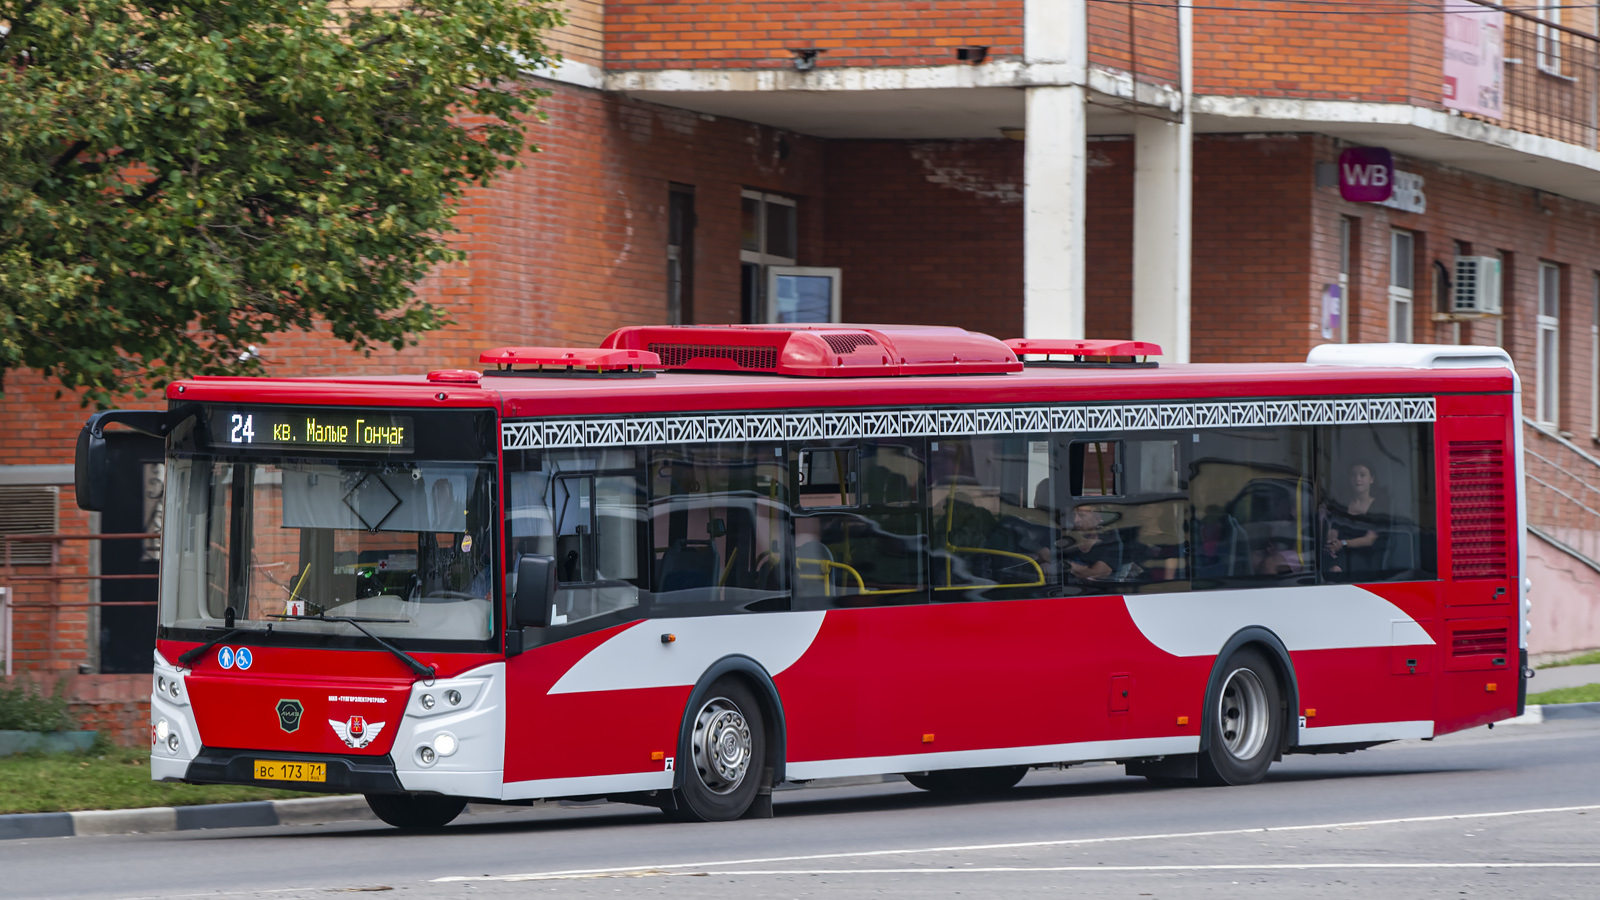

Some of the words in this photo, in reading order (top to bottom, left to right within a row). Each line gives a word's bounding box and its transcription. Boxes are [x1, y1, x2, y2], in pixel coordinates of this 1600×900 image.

[1343, 163, 1388, 186] WB
[231, 414, 254, 443] 24
[273, 424, 296, 441] кв.
[306, 418, 348, 443] Малые
[260, 766, 274, 777] ВС
[281, 764, 302, 778] 173
[310, 764, 321, 776] 71
